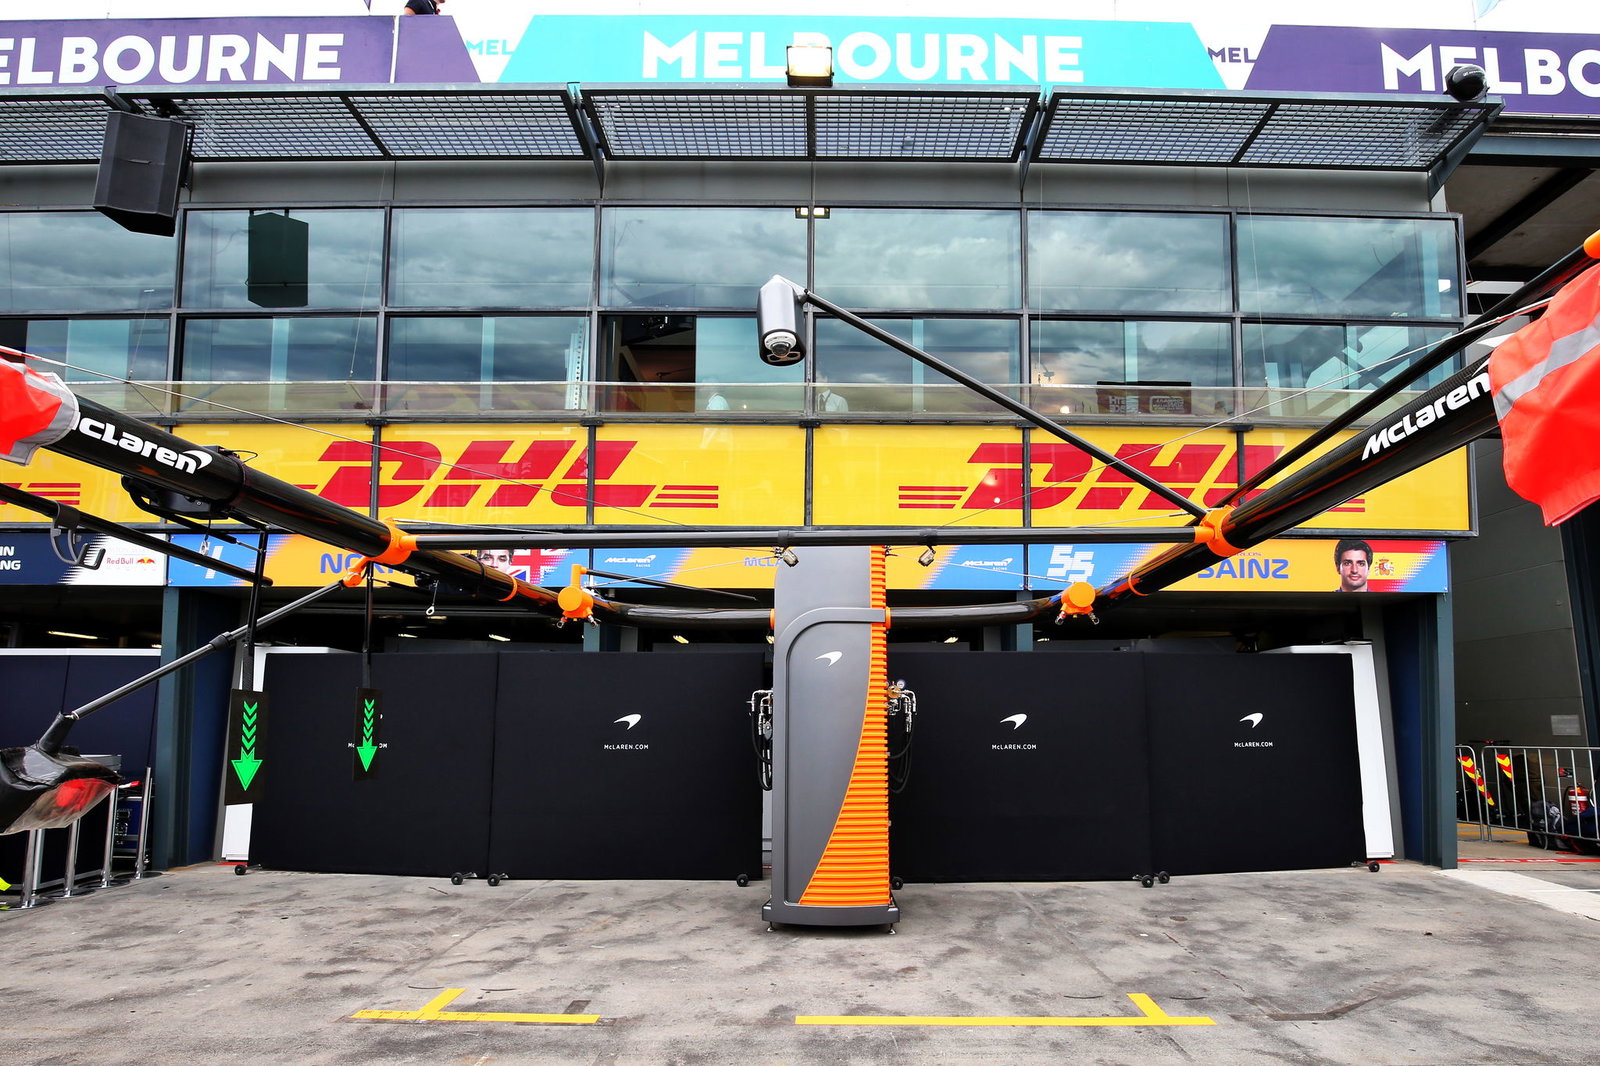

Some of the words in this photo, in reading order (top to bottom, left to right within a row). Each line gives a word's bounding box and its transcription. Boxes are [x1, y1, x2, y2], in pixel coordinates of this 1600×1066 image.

[466, 39, 514, 56] MEL
[642, 30, 1085, 84] MELOURNE
[1207, 46, 1256, 63] MEL
[73, 415, 198, 474] cLaren
[318, 440, 657, 508] DHL
[106, 557, 120, 565] Red
[121, 557, 134, 565] Bull
[1046, 545, 1095, 583] 55
